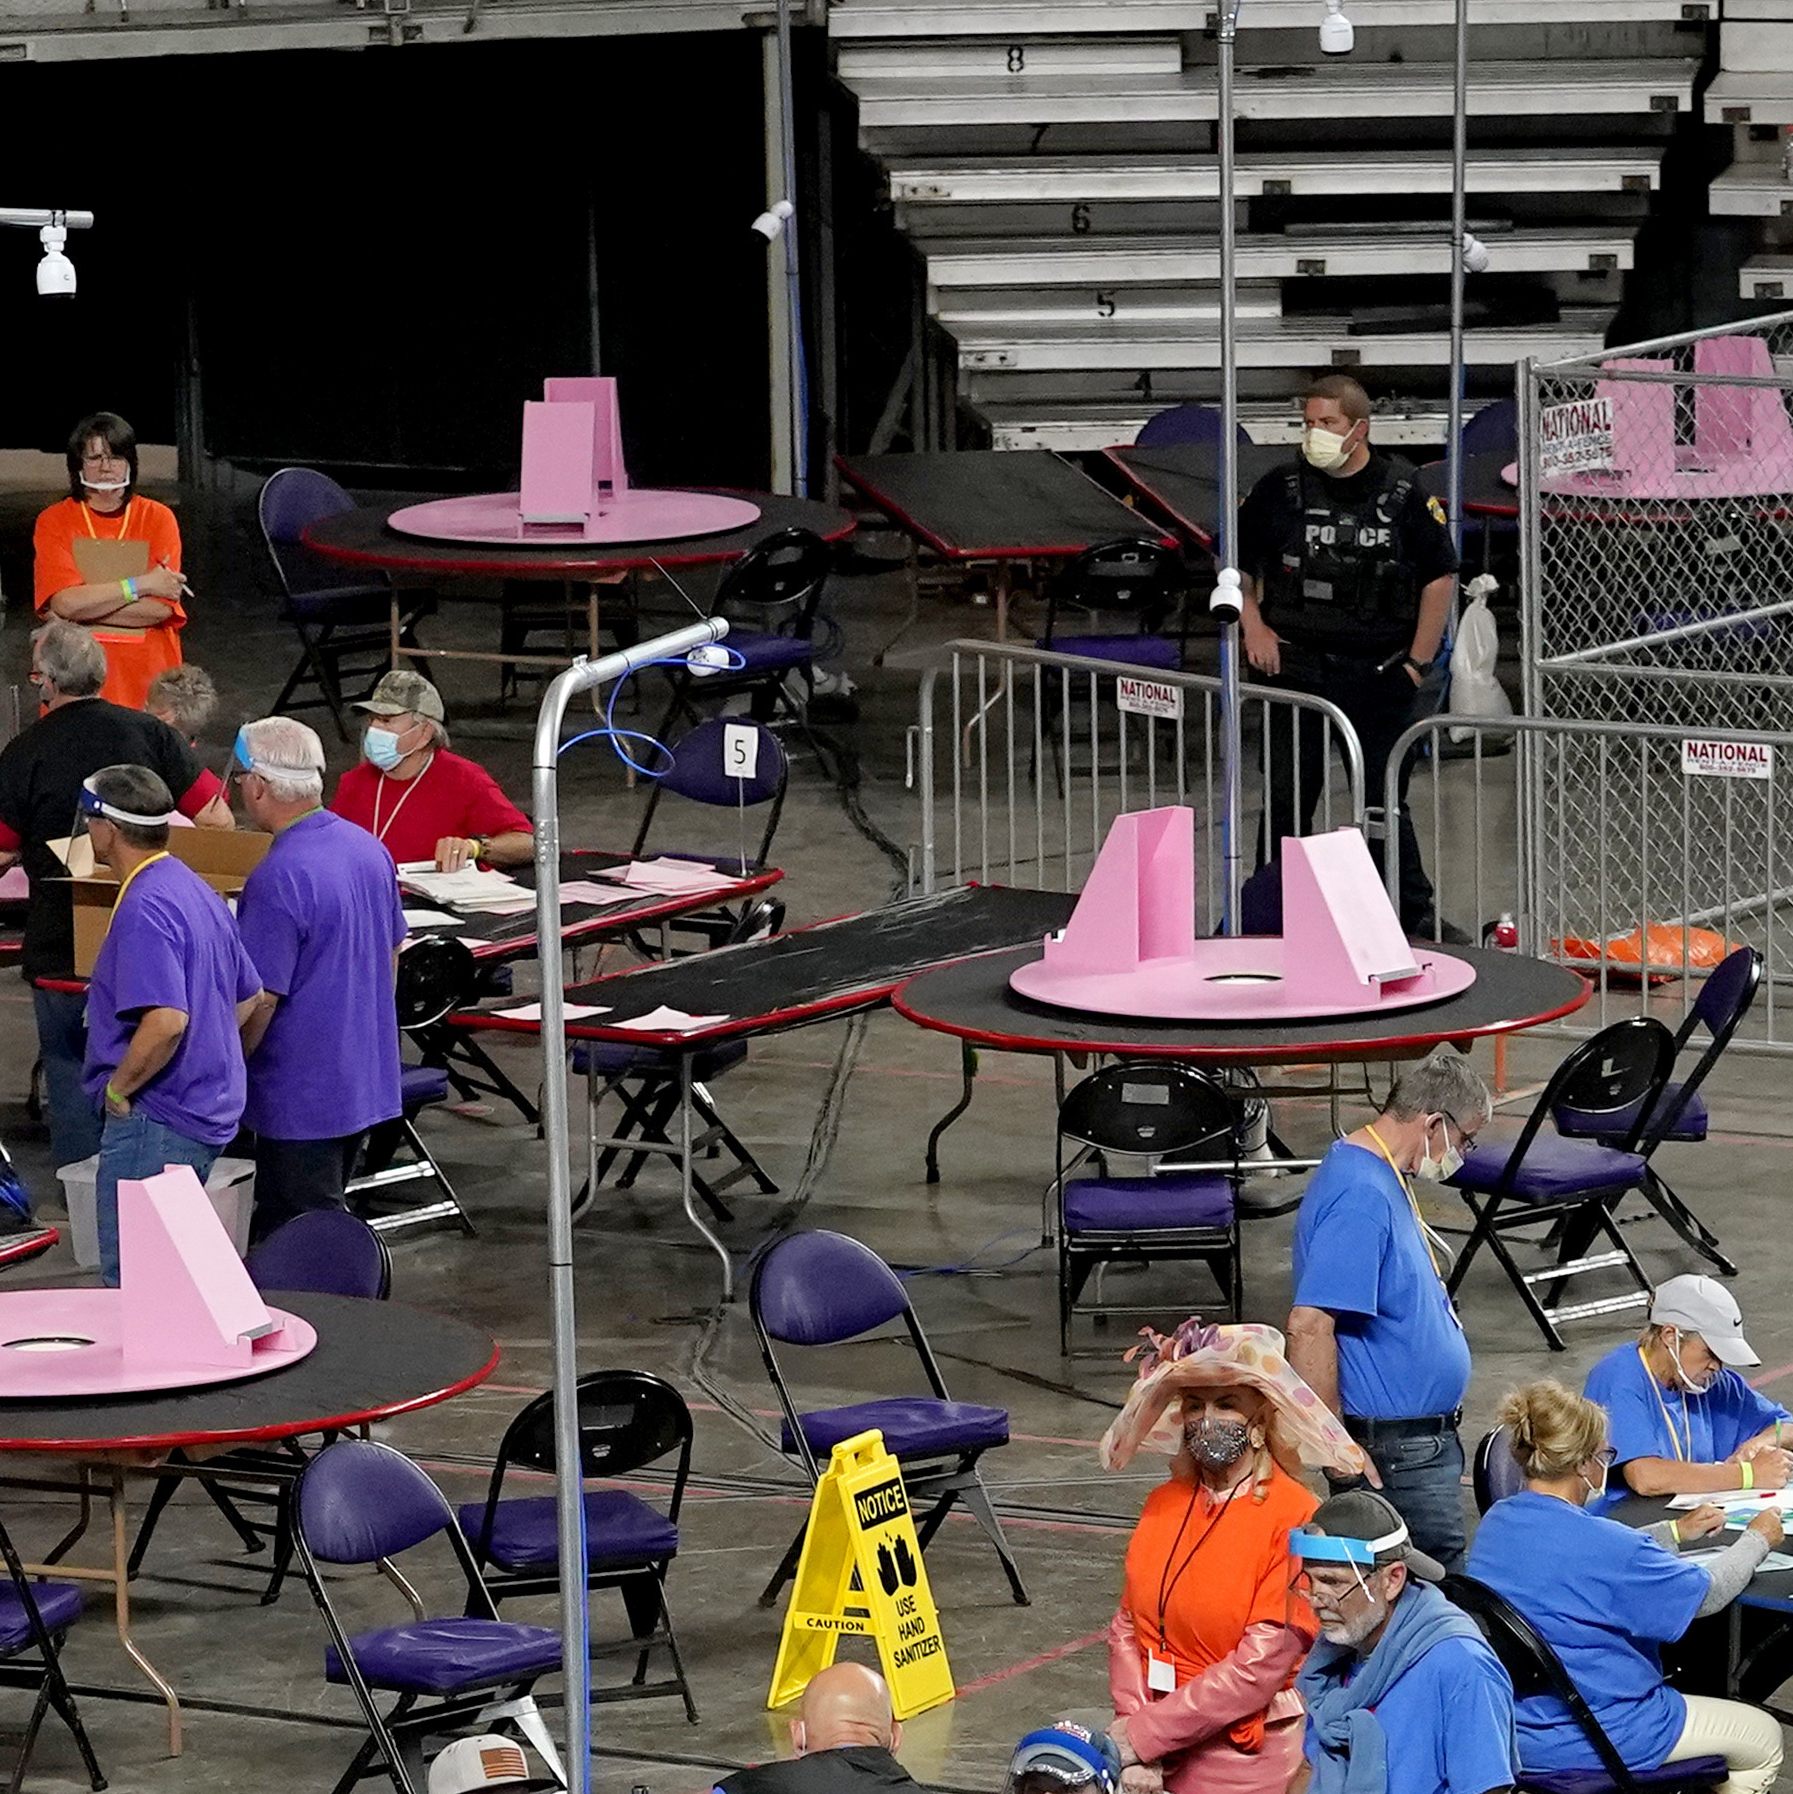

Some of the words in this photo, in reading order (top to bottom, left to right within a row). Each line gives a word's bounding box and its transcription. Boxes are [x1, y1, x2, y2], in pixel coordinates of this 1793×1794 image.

[1007, 45, 1024, 73] 8
[1071, 204, 1090, 234] 6
[1097, 289, 1115, 317] 5
[1120, 679, 1176, 704] NATIONAL
[734, 739, 746, 764] 5
[1687, 742, 1768, 763] NATIONAL
[857, 1484, 905, 1524] NOTICE
[895, 1594, 917, 1618] USE
[806, 1617, 865, 1632] CAUTION
[897, 1616, 926, 1642] HAND
[893, 1634, 942, 1669] SANITIZER
